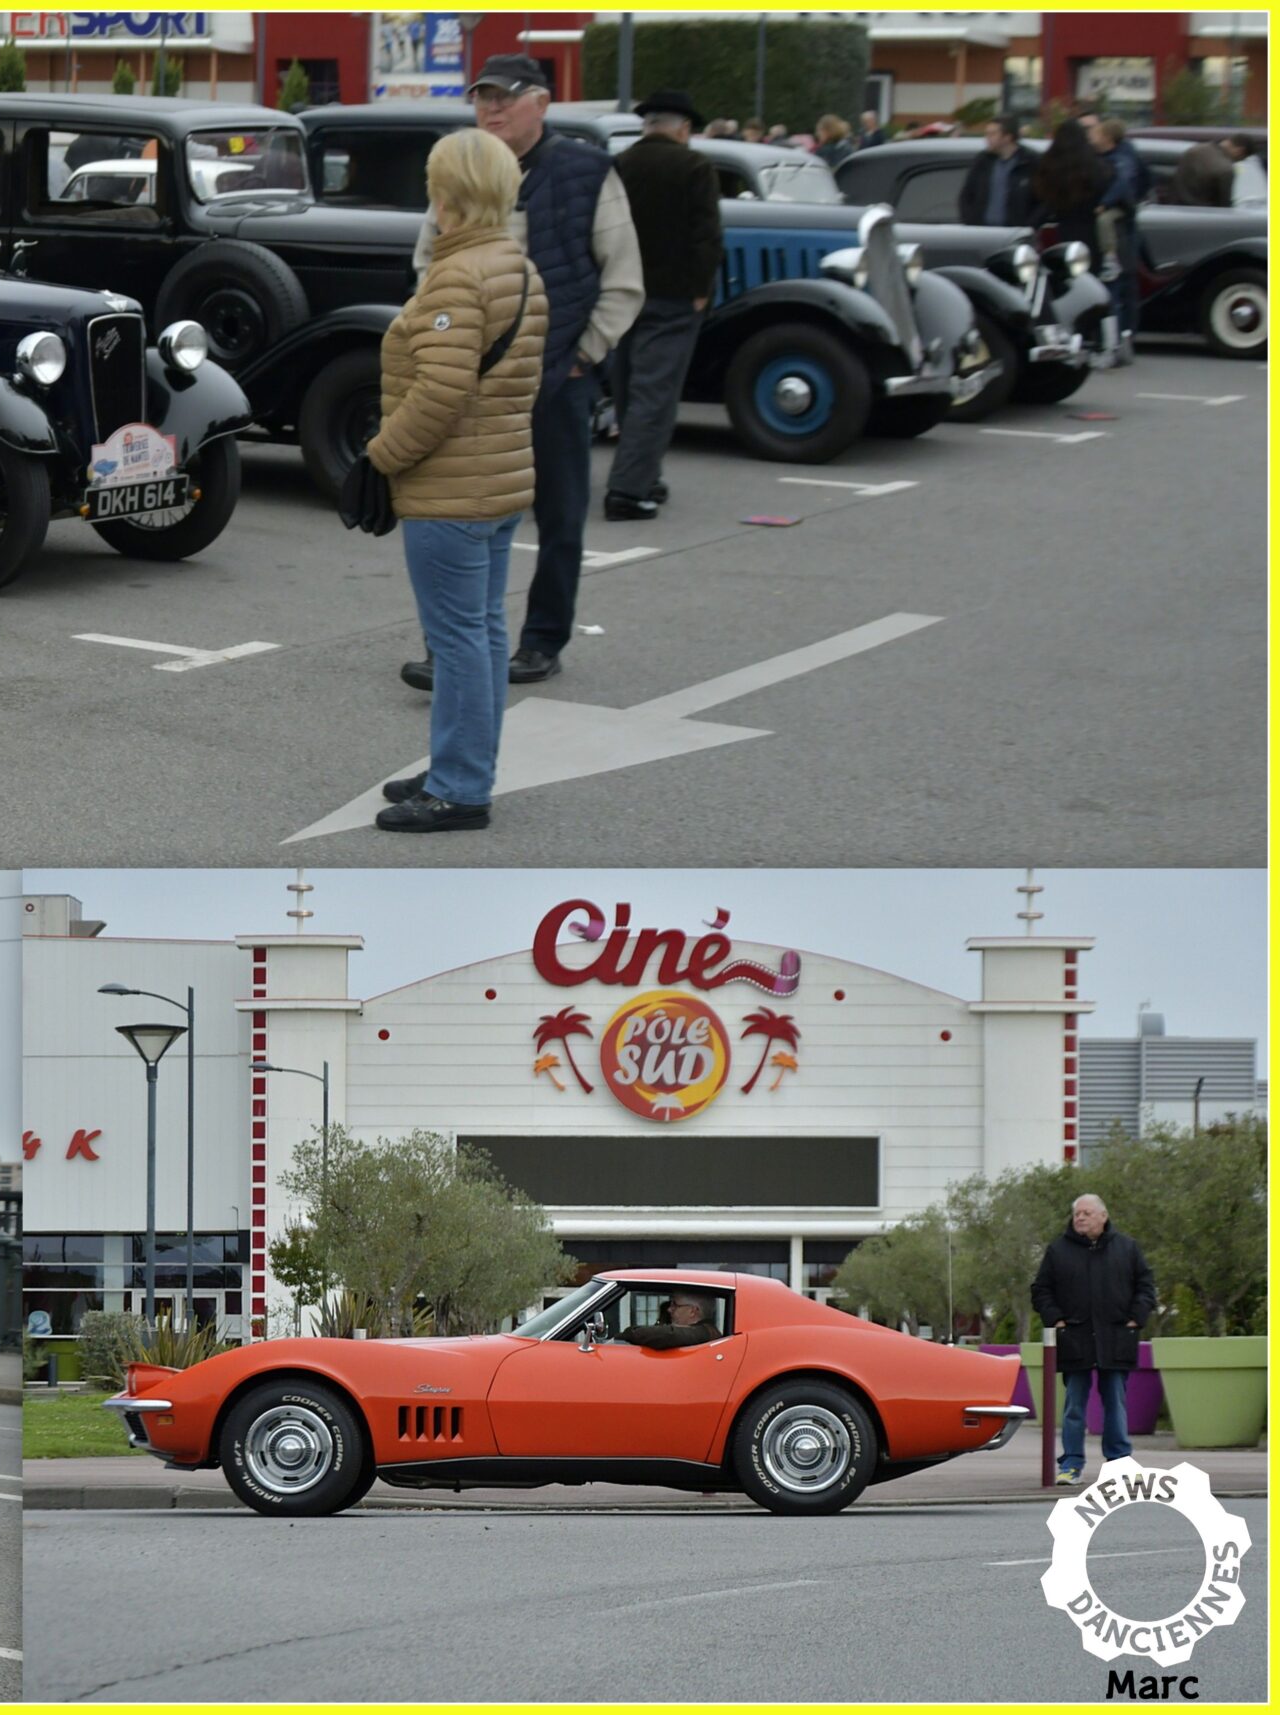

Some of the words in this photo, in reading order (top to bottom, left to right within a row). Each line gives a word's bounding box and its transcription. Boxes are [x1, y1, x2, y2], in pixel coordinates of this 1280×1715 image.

[97, 486, 140, 517] DKH
[143, 481, 176, 509] 614
[533, 898, 740, 991] Ciné
[626, 1009, 710, 1046] PÔLE
[613, 1045, 716, 1087] SUD
[282, 1394, 334, 1421] COOPER
[331, 1425, 344, 1471] COBRA
[753, 1401, 784, 1439] COBRA
[841, 1413, 861, 1460] RADIAL
[242, 1471, 283, 1503] RADIAL
[751, 1444, 780, 1494] COOPER
